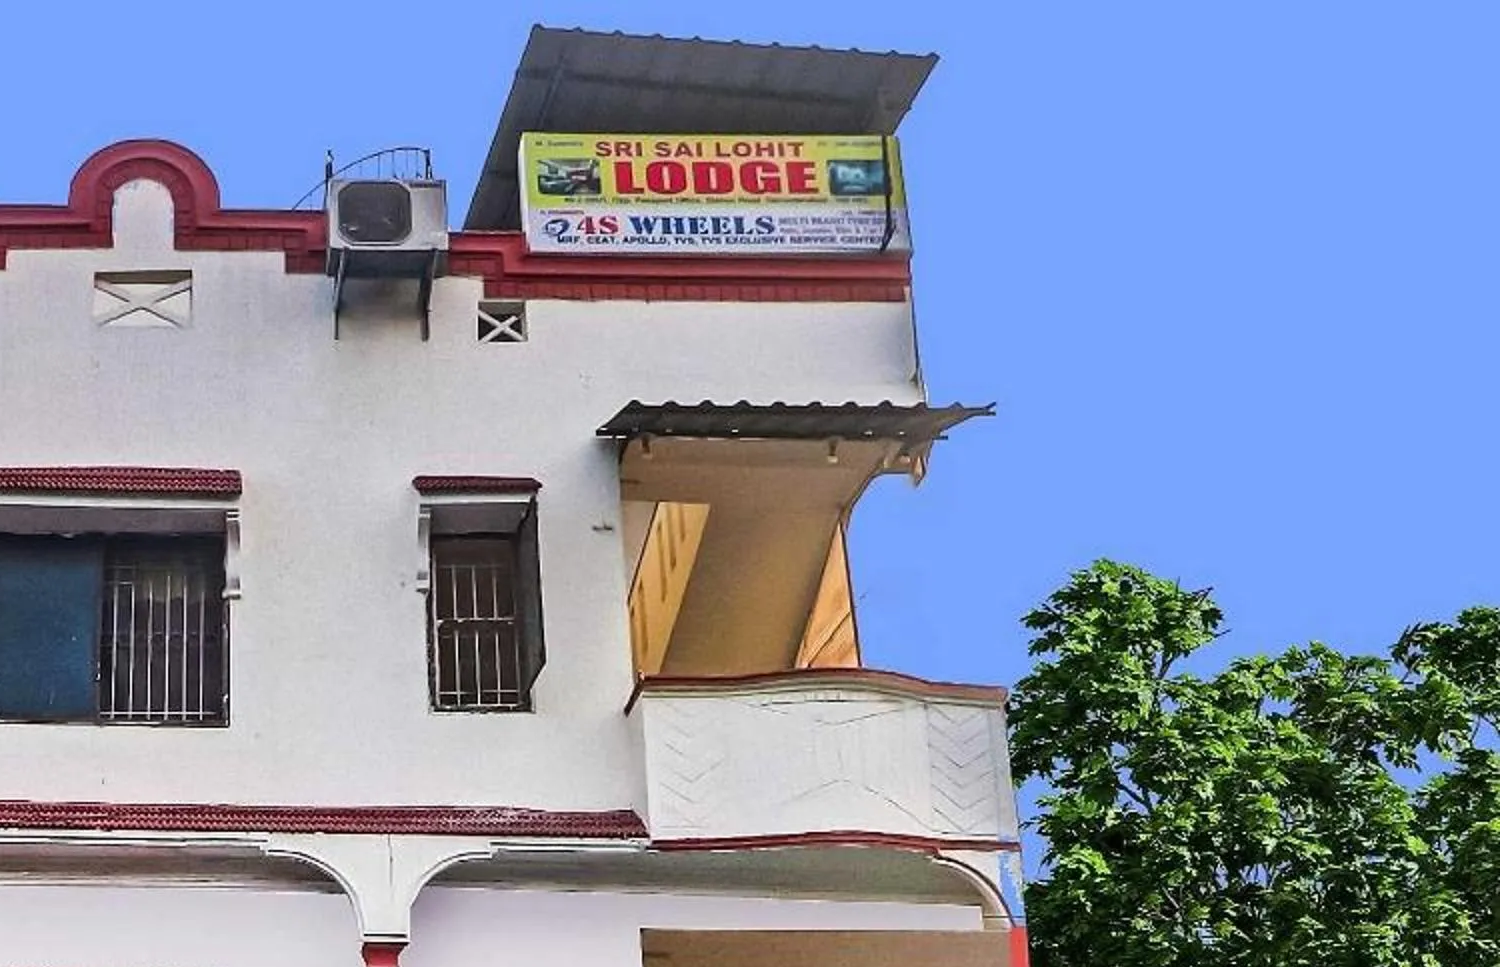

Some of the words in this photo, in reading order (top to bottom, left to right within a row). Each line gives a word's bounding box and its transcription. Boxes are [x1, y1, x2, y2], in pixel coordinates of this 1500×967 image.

[595, 141, 643, 157] SRI
[655, 141, 702, 157] SAI
[715, 141, 804, 157] LOHIT
[614, 160, 819, 195] LODGE
[576, 215, 620, 235] 4S
[628, 215, 776, 236] WHEELS
[622, 236, 670, 246] APOLLO,
[701, 236, 722, 245] TVS
[725, 236, 786, 245] EXCLUSIVE
[790, 236, 835, 245] SERVICE
